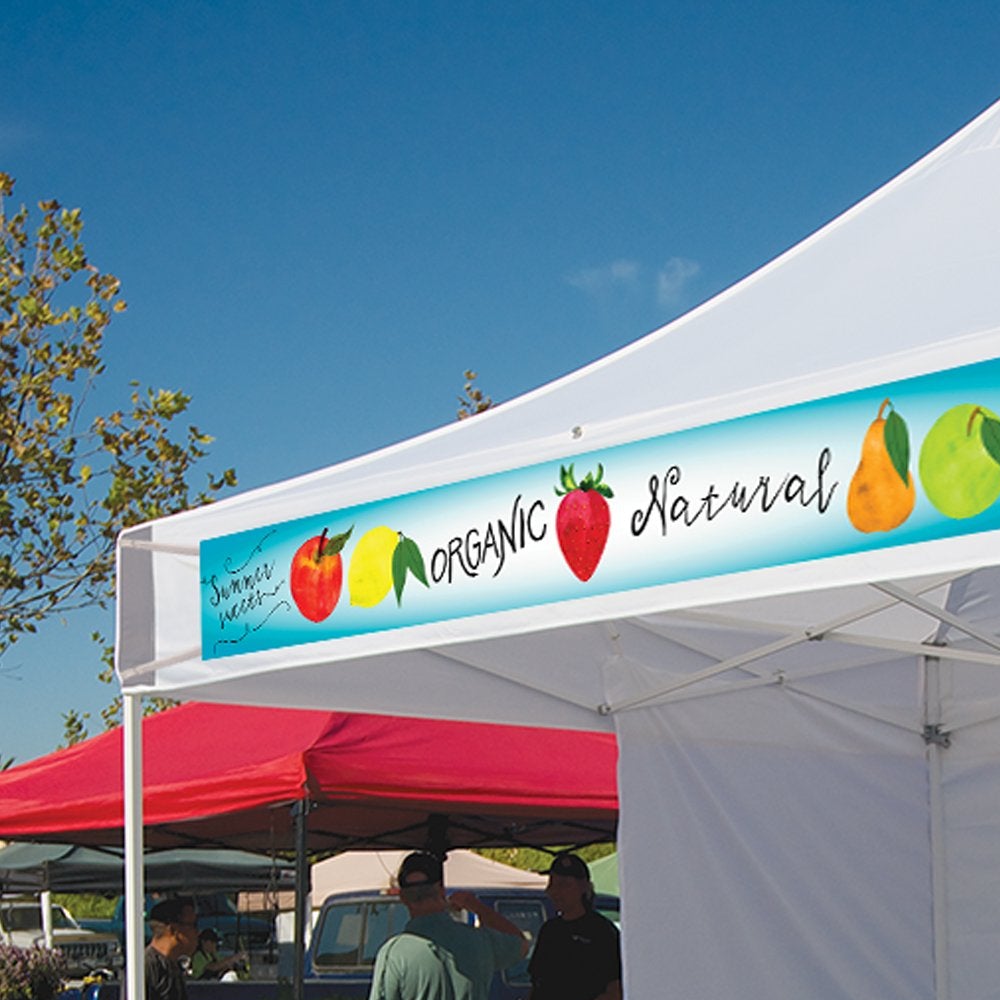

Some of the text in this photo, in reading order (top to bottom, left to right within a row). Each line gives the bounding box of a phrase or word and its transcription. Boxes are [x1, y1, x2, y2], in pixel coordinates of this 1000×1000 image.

[630, 447, 839, 537] Natural
[202, 559, 276, 607] Summer
[430, 494, 547, 584] ORGANIC
